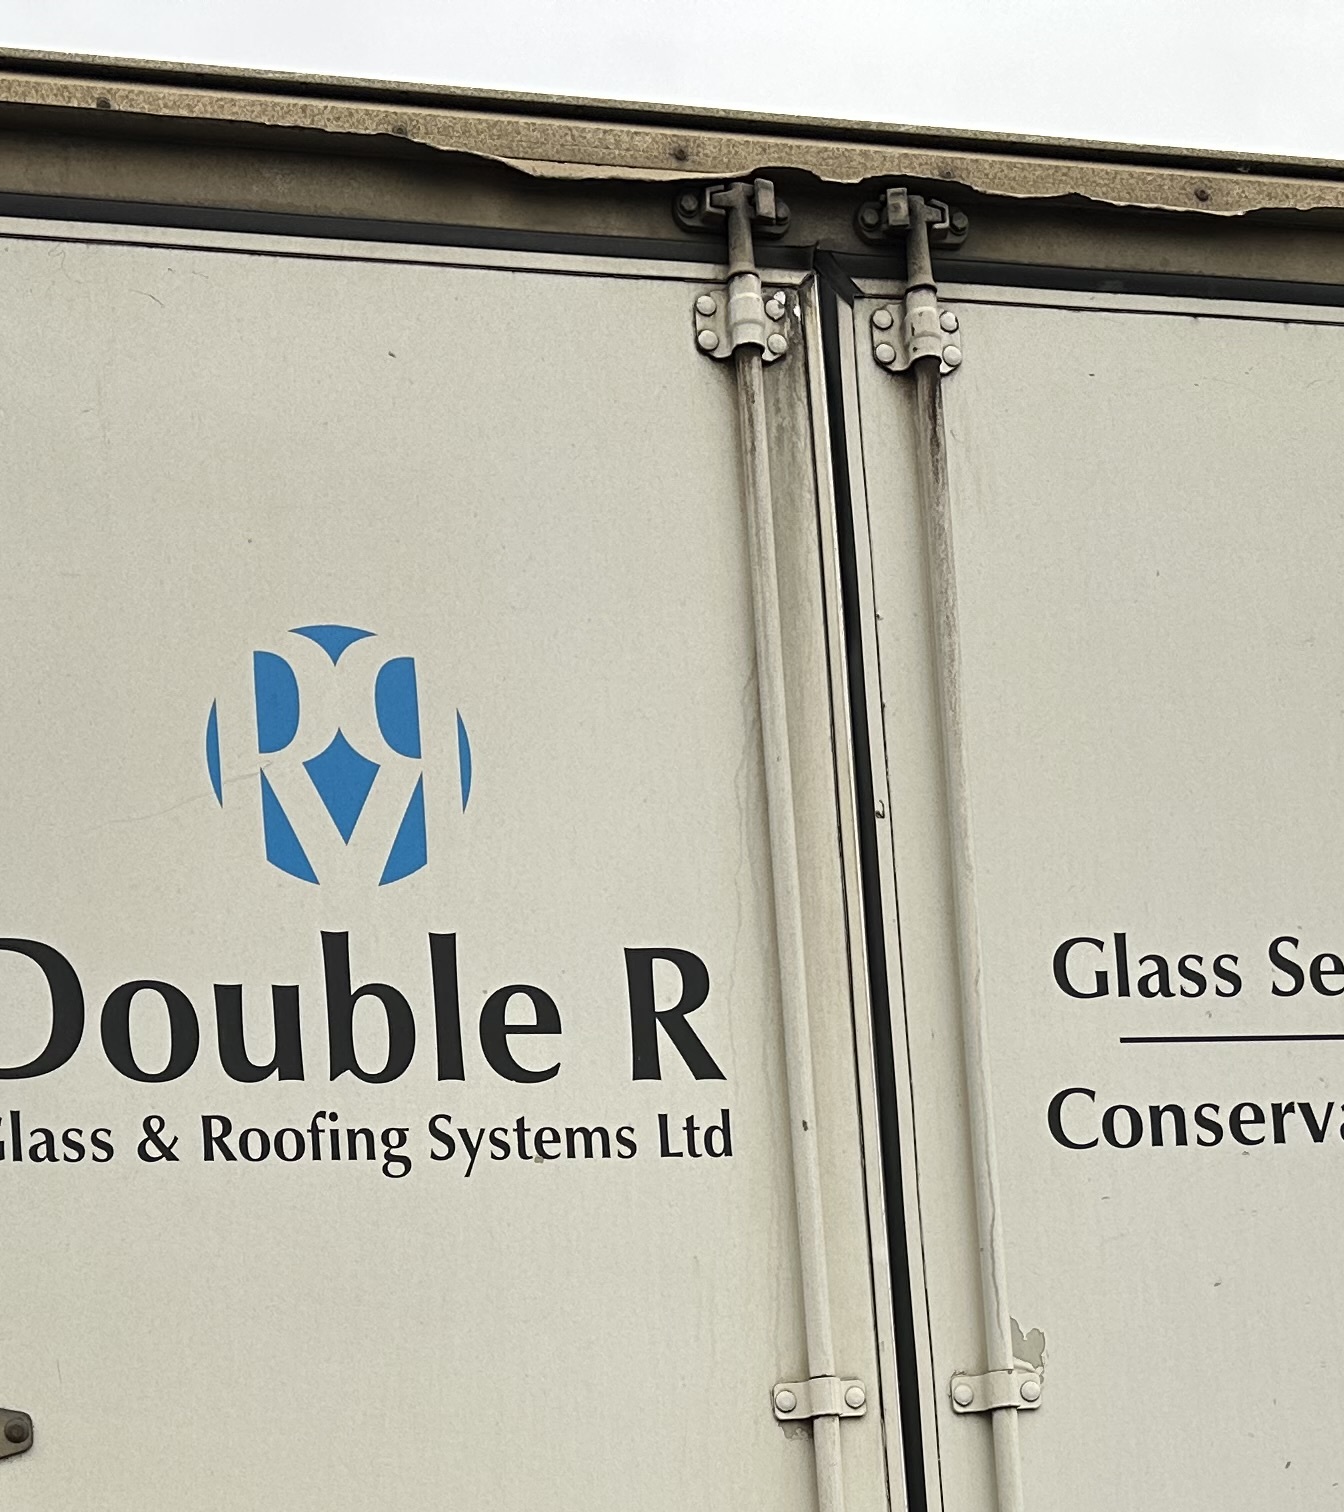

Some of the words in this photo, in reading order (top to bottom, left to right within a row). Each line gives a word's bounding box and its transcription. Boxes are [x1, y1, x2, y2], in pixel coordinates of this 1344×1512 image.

[1052, 931, 1243, 999] Glass
[624, 947, 727, 1081] R
[137, 1115, 180, 1162] &
[201, 1110, 413, 1179] Roofing
[427, 1113, 638, 1177] Systems
[658, 1108, 734, 1160] Ltd
